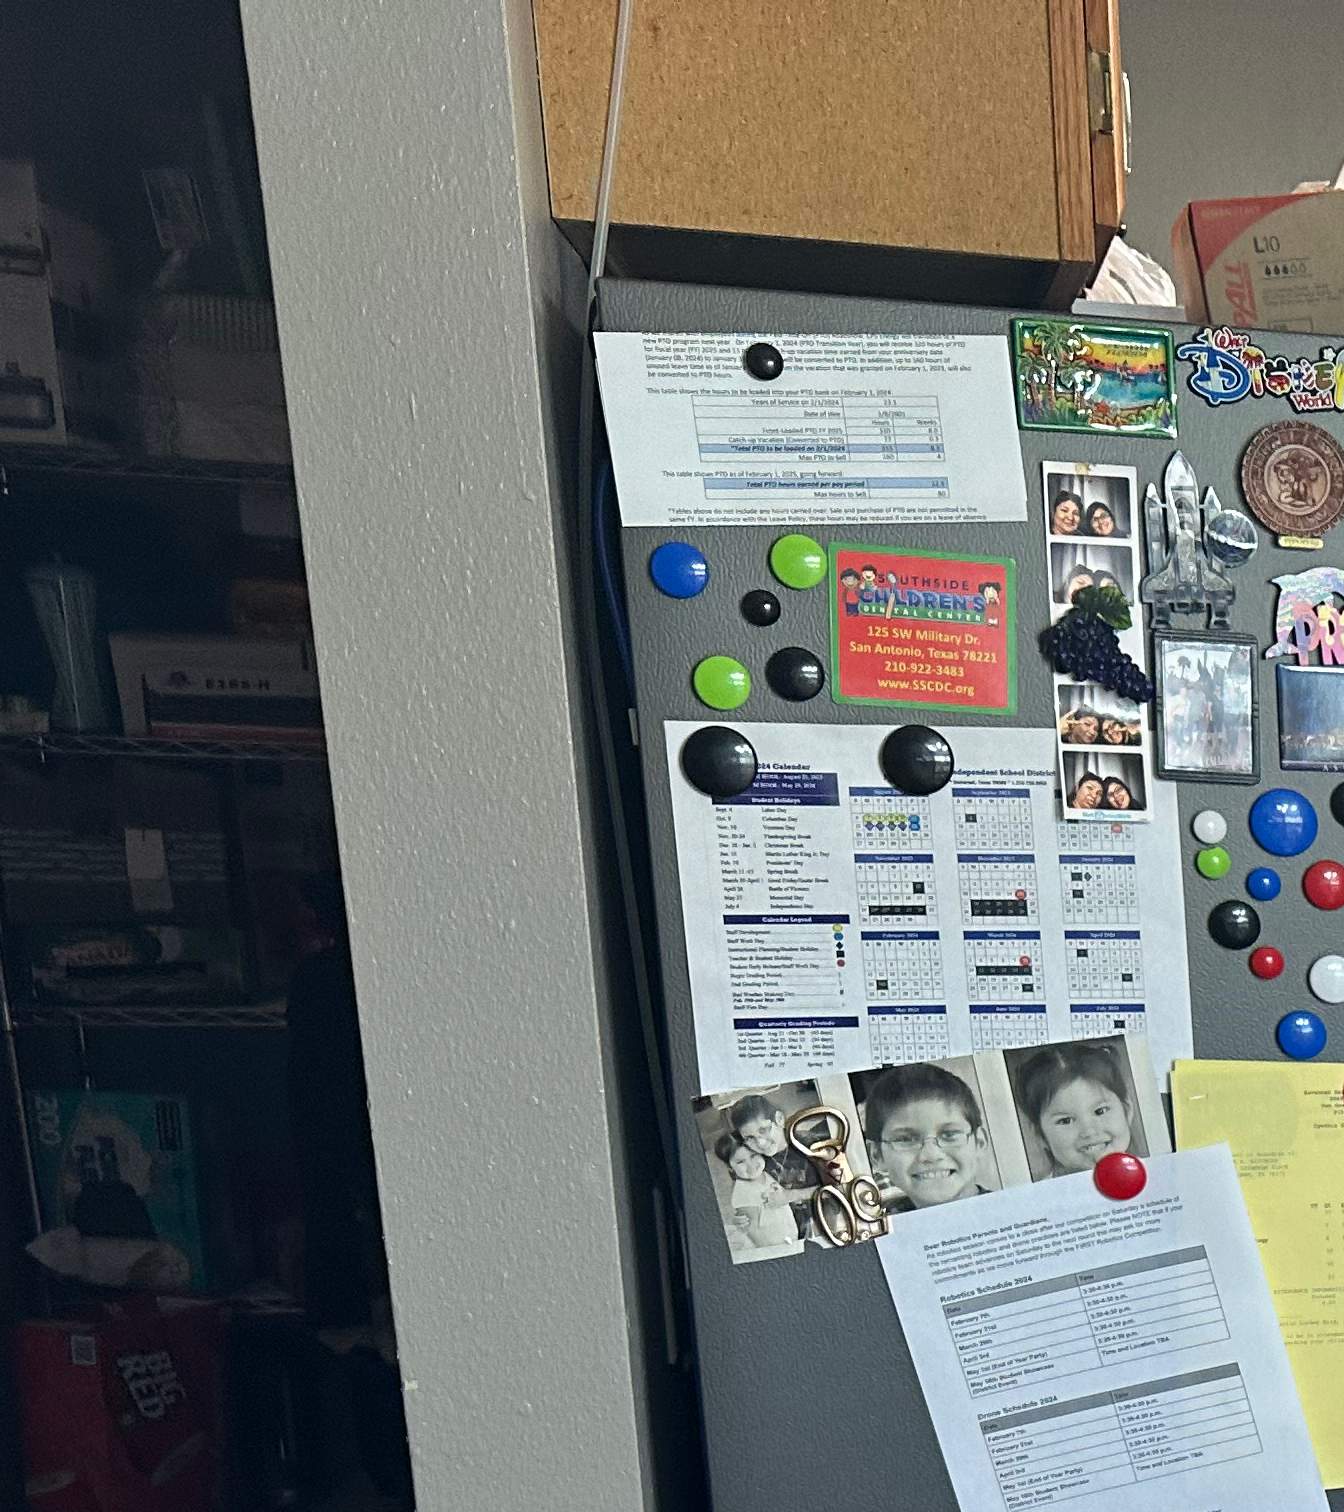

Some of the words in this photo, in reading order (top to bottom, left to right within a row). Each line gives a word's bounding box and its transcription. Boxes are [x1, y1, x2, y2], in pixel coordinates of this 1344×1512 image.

[867, 626, 889, 637] 125
[891, 628, 913, 640] SW
[916, 630, 962, 645] Military
[965, 635, 981, 645] Dr.
[849, 641, 872, 653] San
[874, 643, 925, 659] Antonio,
[928, 648, 960, 661] Texas
[962, 650, 998, 664] 78221
[884, 661, 965, 678] 210-922-3483
[953, 768, 998, 777] ndependent
